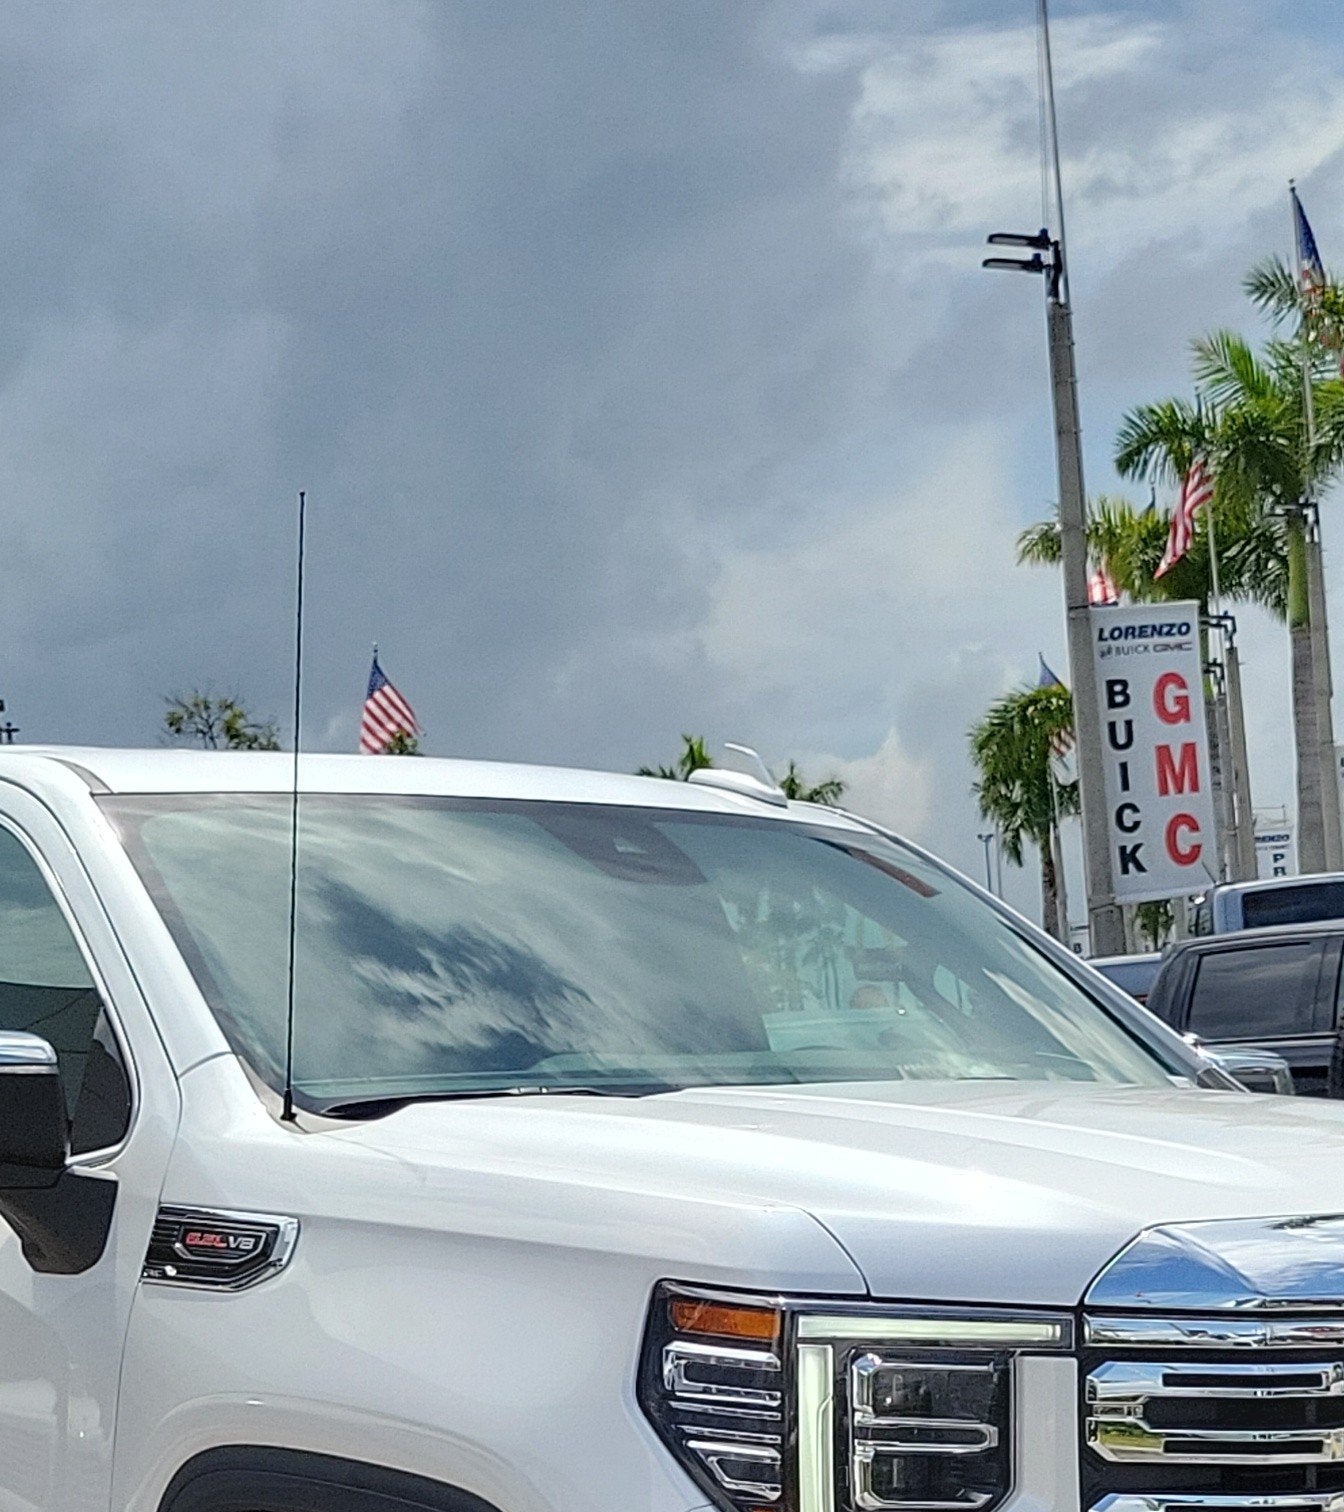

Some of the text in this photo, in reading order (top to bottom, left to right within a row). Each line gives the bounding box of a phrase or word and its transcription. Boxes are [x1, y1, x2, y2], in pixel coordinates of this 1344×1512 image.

[1097, 622, 1191, 641] LORENZO
[1105, 679, 1148, 875] BUICK
[1153, 672, 1203, 867] GMC
[228, 1235, 256, 1250] V8
